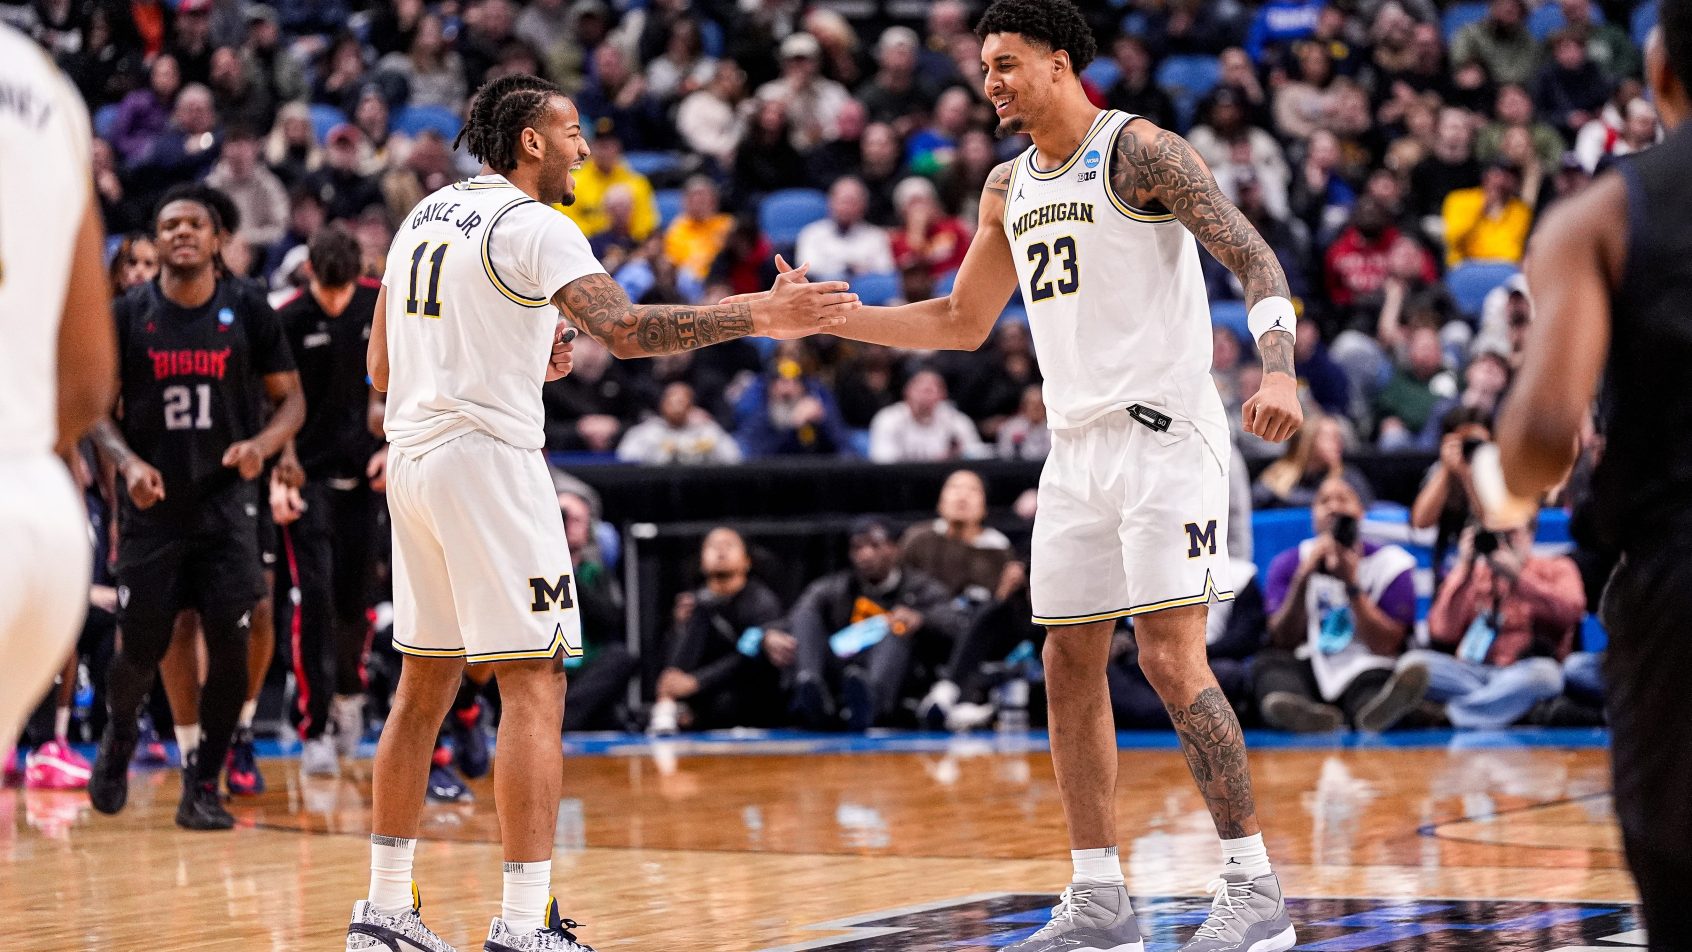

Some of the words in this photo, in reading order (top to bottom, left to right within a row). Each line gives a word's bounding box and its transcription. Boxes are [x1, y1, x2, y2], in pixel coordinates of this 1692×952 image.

[411, 202, 461, 230] GAYLE
[455, 210, 482, 239] JR.
[1012, 202, 1094, 241] MICHIGAN
[405, 240, 449, 318] 11
[1026, 235, 1080, 302] 23
[148, 347, 232, 381] BISON
[163, 383, 213, 430] 21
[1184, 519, 1218, 559] M
[528, 574, 574, 613] M
